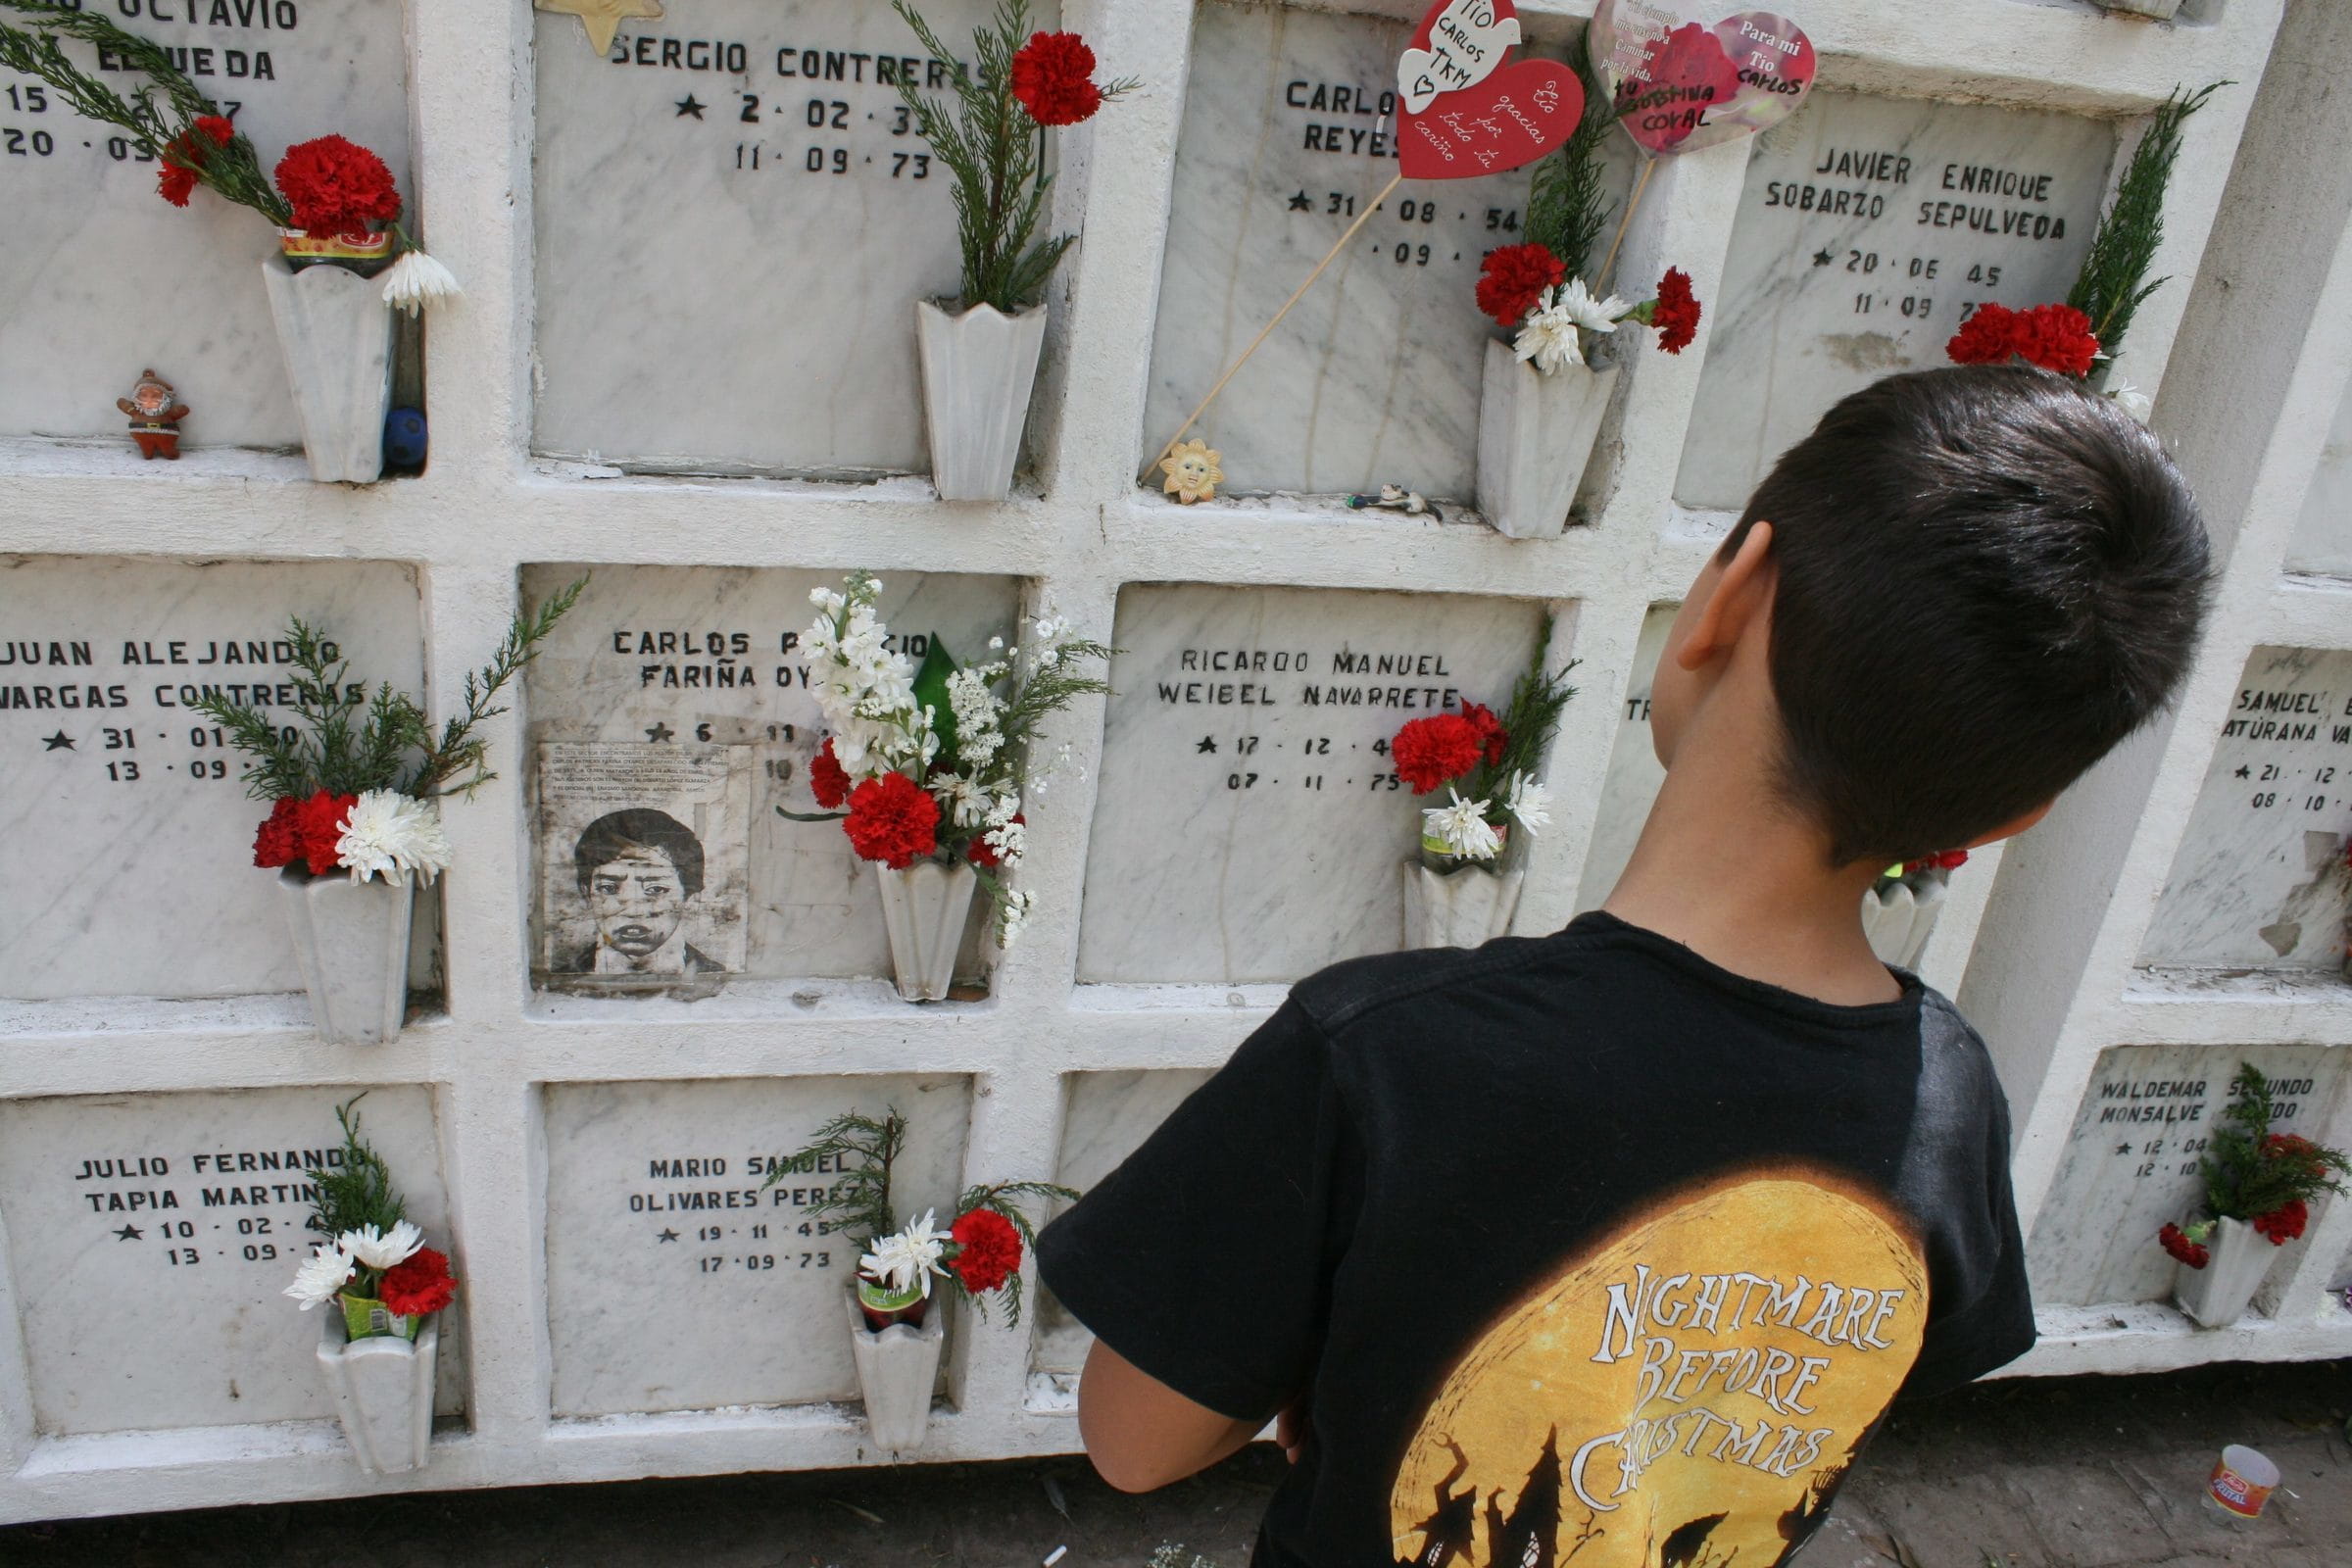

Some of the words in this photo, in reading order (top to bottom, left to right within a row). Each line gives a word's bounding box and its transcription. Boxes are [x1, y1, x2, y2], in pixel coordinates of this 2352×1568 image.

[1438, 17, 1485, 64] CARLOS
[1740, 21, 1776, 47] Para
[612, 35, 747, 74] SERGIO
[1600, 58, 1619, 73] por
[1619, 61, 1631, 74] la
[6, 84, 48, 114] 15
[740, 94, 760, 123] 2
[808, 100, 850, 129] 02
[1492, 95, 1545, 145] gracias
[3, 128, 53, 157] 20
[735, 144, 760, 171] 11
[806, 147, 849, 174] 09
[892, 152, 930, 179] 73
[1816, 149, 1912, 184] JAVIER
[1327, 192, 1354, 217] 31
[1399, 200, 1436, 223] 08
[1486, 209, 1518, 232] 54
[1765, 182, 1885, 219] SOBARZO
[1917, 202, 2066, 239] SEPULVEDA
[1396, 243, 1431, 266] 09
[1846, 250, 1878, 272] 20
[1967, 265, 2001, 286] 45
[1854, 293, 1870, 314] 11
[1901, 298, 1932, 318] 09
[0, 641, 93, 665] JUAN
[122, 641, 339, 665] ALEJANDO
[613, 630, 750, 656] CARLOS
[641, 659, 756, 689] FARIÑA
[1181, 650, 1309, 672] RICARDO
[1332, 652, 1450, 676] MANUEL
[1158, 683, 1276, 706] WEIBEL
[1303, 685, 1458, 709] NAVARRETE
[2235, 689, 2320, 714] SAMUEL
[104, 728, 136, 750] 31
[190, 727, 224, 748] 01
[697, 723, 711, 742] 6
[1305, 738, 1330, 756] 12
[105, 760, 140, 781] 13
[190, 760, 227, 779] 09
[1227, 773, 1258, 790] 07
[1305, 774, 1322, 791] 11
[2260, 764, 2279, 781] 21
[2315, 767, 2334, 784] 12
[2252, 792, 2276, 808] 08
[2304, 795, 2325, 811] 10
[2101, 1080, 2207, 1099] WALDEMAR
[2100, 1104, 2204, 1123] MONSALVE
[2142, 1141, 2162, 1154] 12
[2183, 1139, 2207, 1153] 04
[75, 1156, 169, 1180] JULIO
[650, 1158, 726, 1178] MARIO
[2136, 1163, 2155, 1177] 12
[2180, 1162, 2196, 1175] 10
[85, 1190, 179, 1212] TAPIA
[629, 1190, 759, 1212] OLIVARES
[161, 1221, 194, 1239] 10
[238, 1217, 271, 1235] 02
[699, 1226, 721, 1241] 19
[752, 1225, 767, 1239] 11
[798, 1221, 831, 1237] 45
[168, 1248, 200, 1265] 13
[244, 1245, 276, 1261] 09
[700, 1257, 723, 1273] 17
[747, 1254, 774, 1270] 09
[800, 1251, 830, 1268] 73
[1590, 1263, 1905, 1363] NIGHTMARE
[1631, 1337, 1832, 1419] BEFORE
[1570, 1406, 1834, 1511] CHRISTMAS
